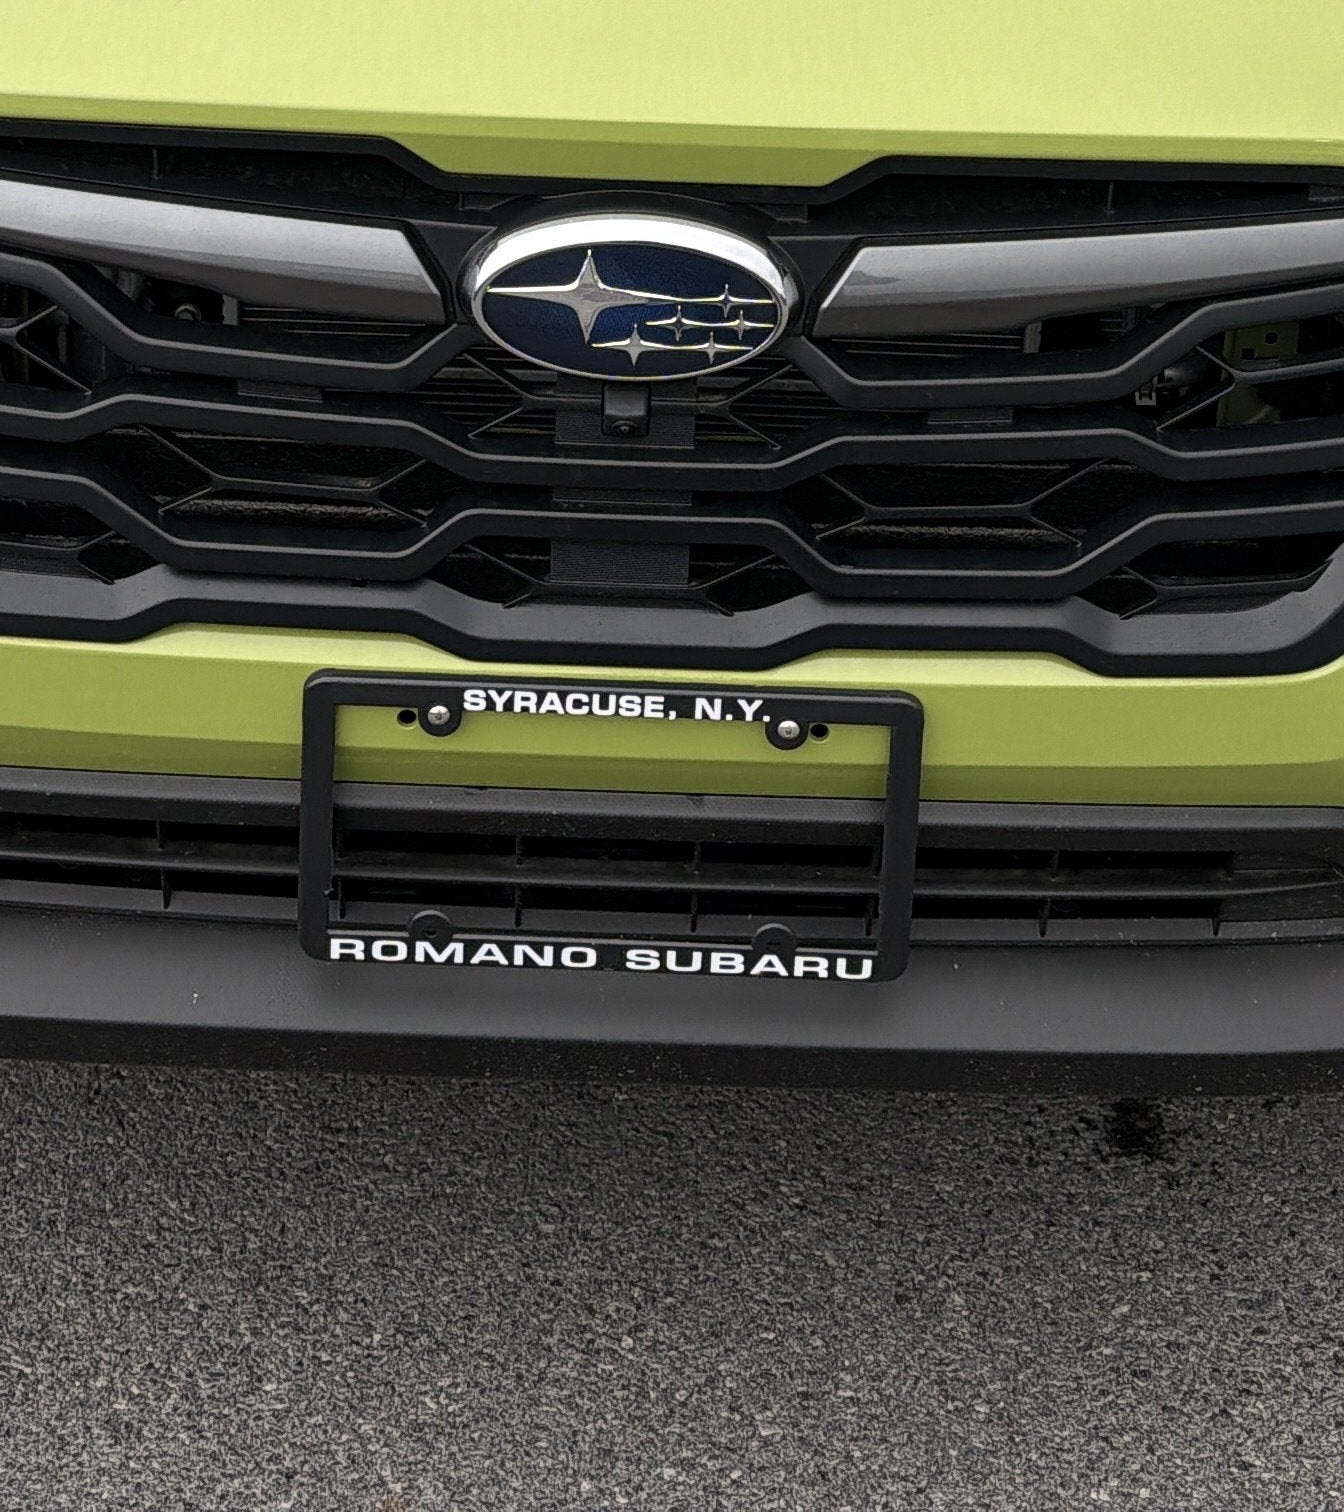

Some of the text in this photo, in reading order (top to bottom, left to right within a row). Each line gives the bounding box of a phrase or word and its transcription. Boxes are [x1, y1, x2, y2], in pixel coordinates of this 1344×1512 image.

[463, 689, 771, 723] SYRACUSE, N.Y.
[329, 938, 874, 980] ROMANO SUBARU
